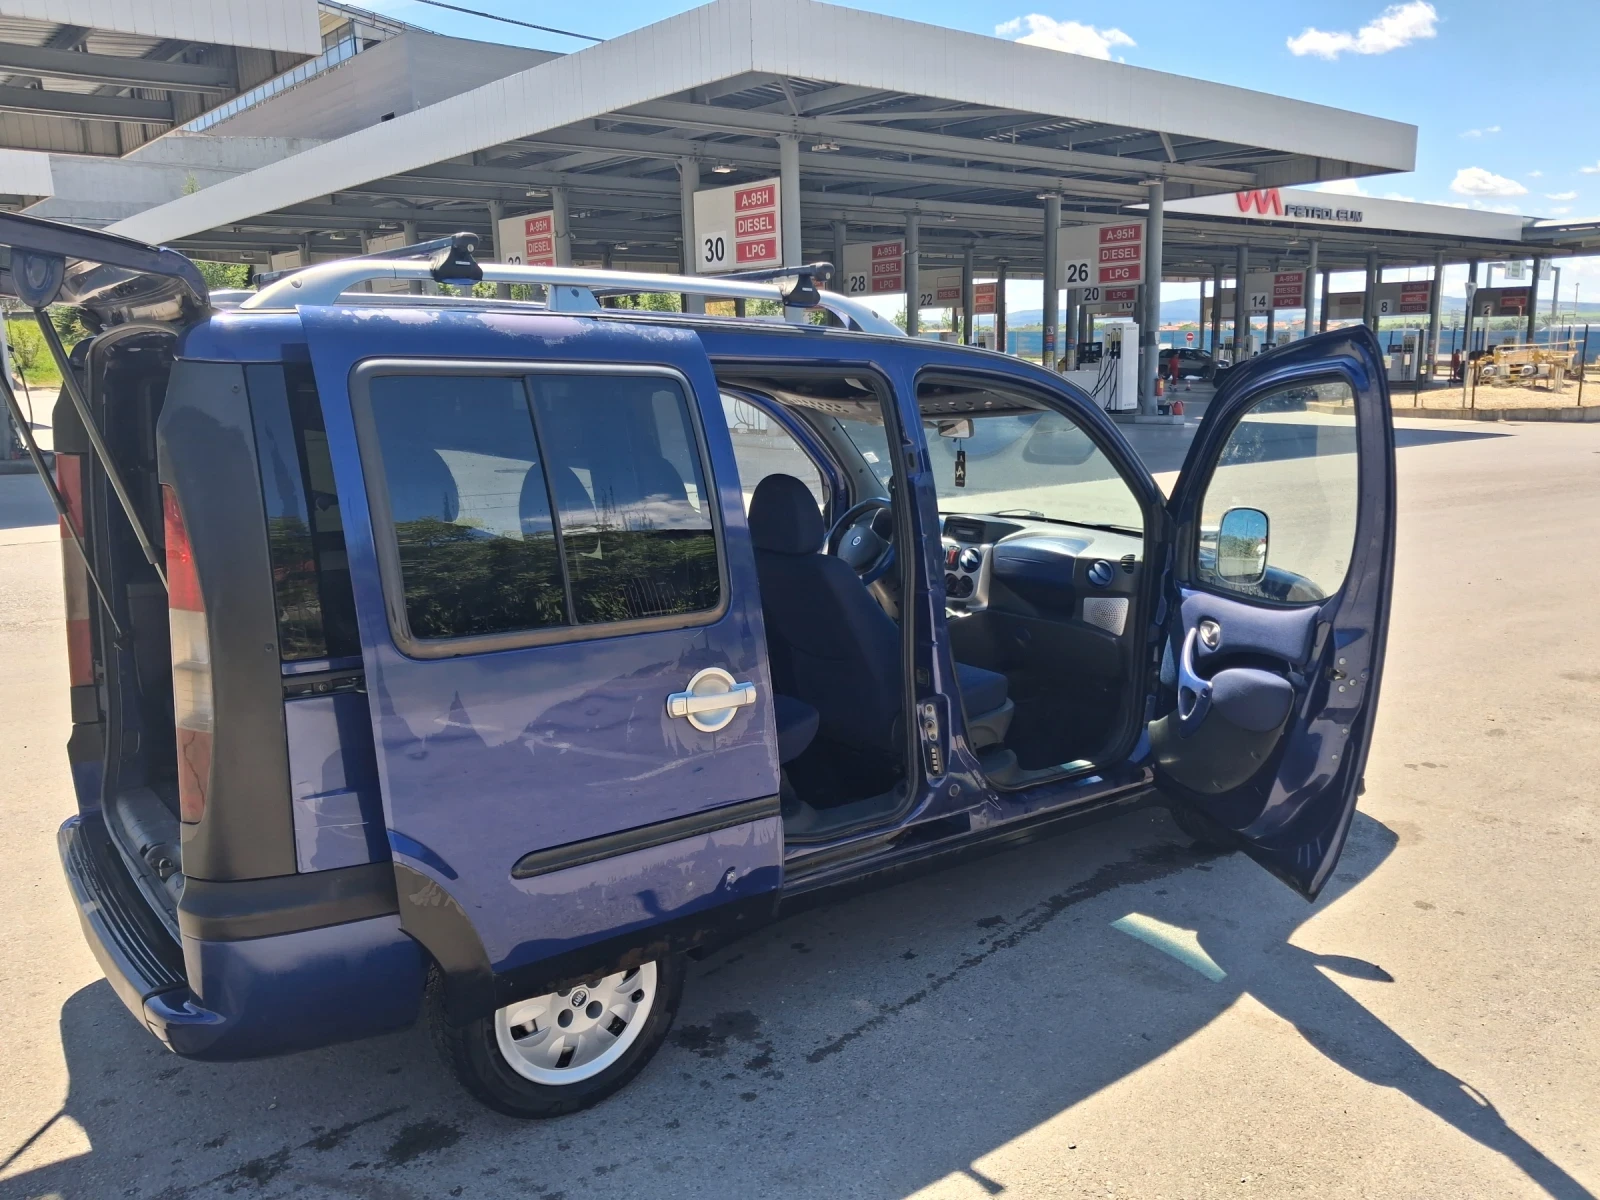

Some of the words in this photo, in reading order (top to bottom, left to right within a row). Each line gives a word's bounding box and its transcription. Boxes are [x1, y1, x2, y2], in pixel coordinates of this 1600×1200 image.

[741, 190, 769, 207] A-95H
[529, 220, 548, 233] A-95H
[738, 217, 772, 233] DIESEL
[1106, 228, 1135, 240] A-95H
[528, 241, 551, 253] DIESEL
[705, 237, 725, 262] 30
[746, 244, 766, 258] LPG
[877, 246, 897, 257] A-95H
[1102, 248, 1137, 260] DIESEL
[874, 263, 899, 273] DIESEL
[1067, 263, 1089, 283] 26
[1109, 268, 1130, 279] LPG
[850, 275, 866, 292] 28
[880, 280, 894, 289] LPG
[1279, 275, 1299, 283] A-95H
[938, 290, 958, 298] DIESEL
[1084, 287, 1100, 301] 20
[1112, 291, 1128, 299] LPG
[1276, 286, 1300, 294] DIESEL
[920, 293, 933, 306] 22
[1251, 295, 1267, 307] 14
[1381, 301, 1389, 312] 8
